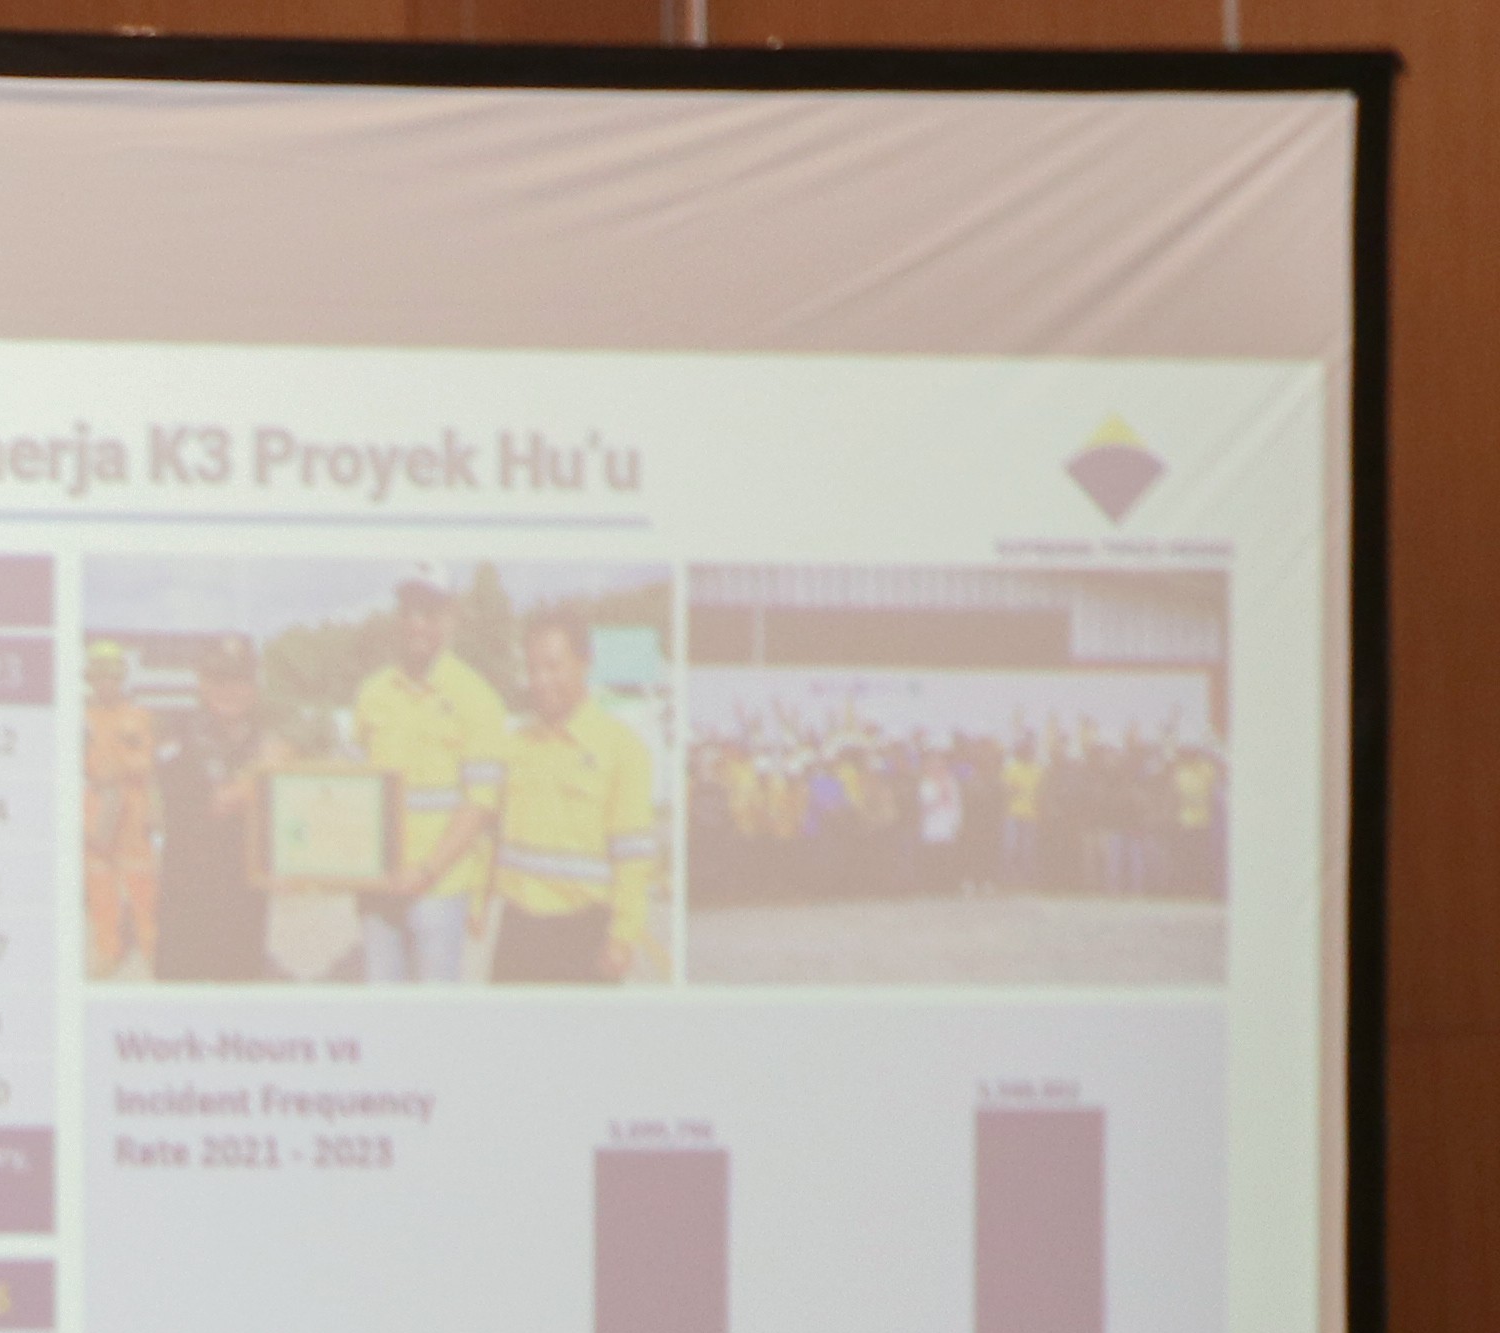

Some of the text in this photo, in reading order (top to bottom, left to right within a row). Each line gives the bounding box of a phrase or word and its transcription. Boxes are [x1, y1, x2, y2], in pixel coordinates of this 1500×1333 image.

[148, 424, 232, 484] K3
[254, 425, 479, 502] Proyek
[498, 429, 641, 492] Hu'u
[114, 1083, 437, 1126] Incident Frequency
[114, 1134, 190, 1168] Rate
